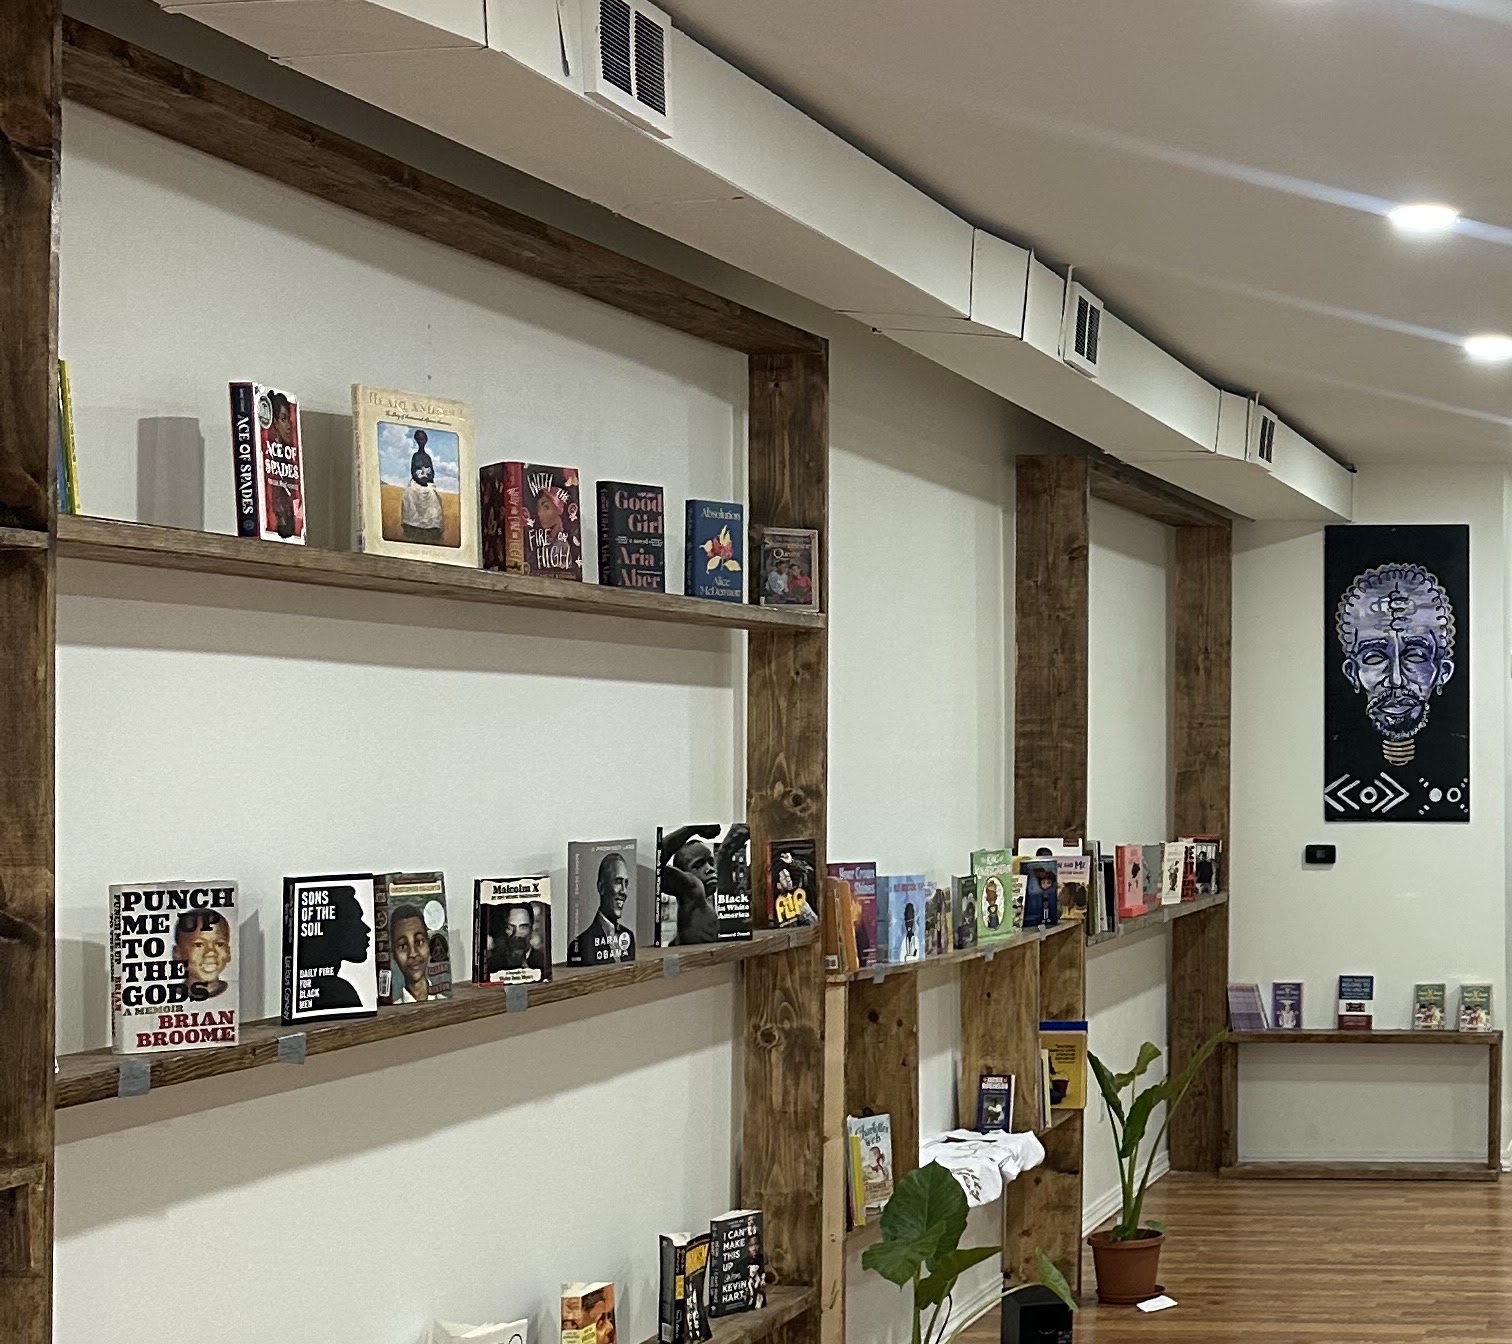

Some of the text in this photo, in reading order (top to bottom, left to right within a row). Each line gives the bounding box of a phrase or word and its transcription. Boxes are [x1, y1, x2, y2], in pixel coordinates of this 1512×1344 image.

[236, 415, 250, 441] ACE
[239, 443, 251, 463] OF
[265, 438, 297, 461] ACE OF
[265, 458, 299, 480] SPADES
[239, 464, 254, 515] SPADES
[527, 471, 553, 497] WITH
[556, 487, 570, 504] THE
[614, 490, 663, 513] Good
[702, 505, 741, 521] Absolution
[627, 514, 663, 534] Girl
[528, 528, 568, 551] FIRE ON
[536, 543, 571, 570] HIGH
[617, 546, 655, 567] Aria
[617, 568, 661, 588] Aber
[713, 576, 731, 587] Alice
[301, 890, 329, 906] SONS
[492, 883, 540, 894] Malcolm X
[121, 887, 235, 912] PUNCH
[717, 894, 750, 904] Black
[717, 903, 750, 912] in White
[121, 911, 221, 935] ME UP
[301, 905, 336, 922] OF THE
[717, 911, 750, 920] America
[300, 921, 324, 938] SOIL
[122, 937, 166, 960] TO
[596, 948, 629, 960] OBAMA
[122, 960, 190, 983] THE
[121, 981, 210, 1007] GODS
[122, 1005, 185, 1016] A MEMOIR
[158, 1010, 235, 1029] BRIAN
[136, 1026, 235, 1048] BROOME
[722, 1238, 746, 1251] MAKE
[723, 1232, 726, 1241] I
[722, 1250, 741, 1262] THIS
[722, 1262, 734, 1272] UP
[722, 1280, 747, 1293] KEVIN
[722, 1290, 744, 1304] HART
